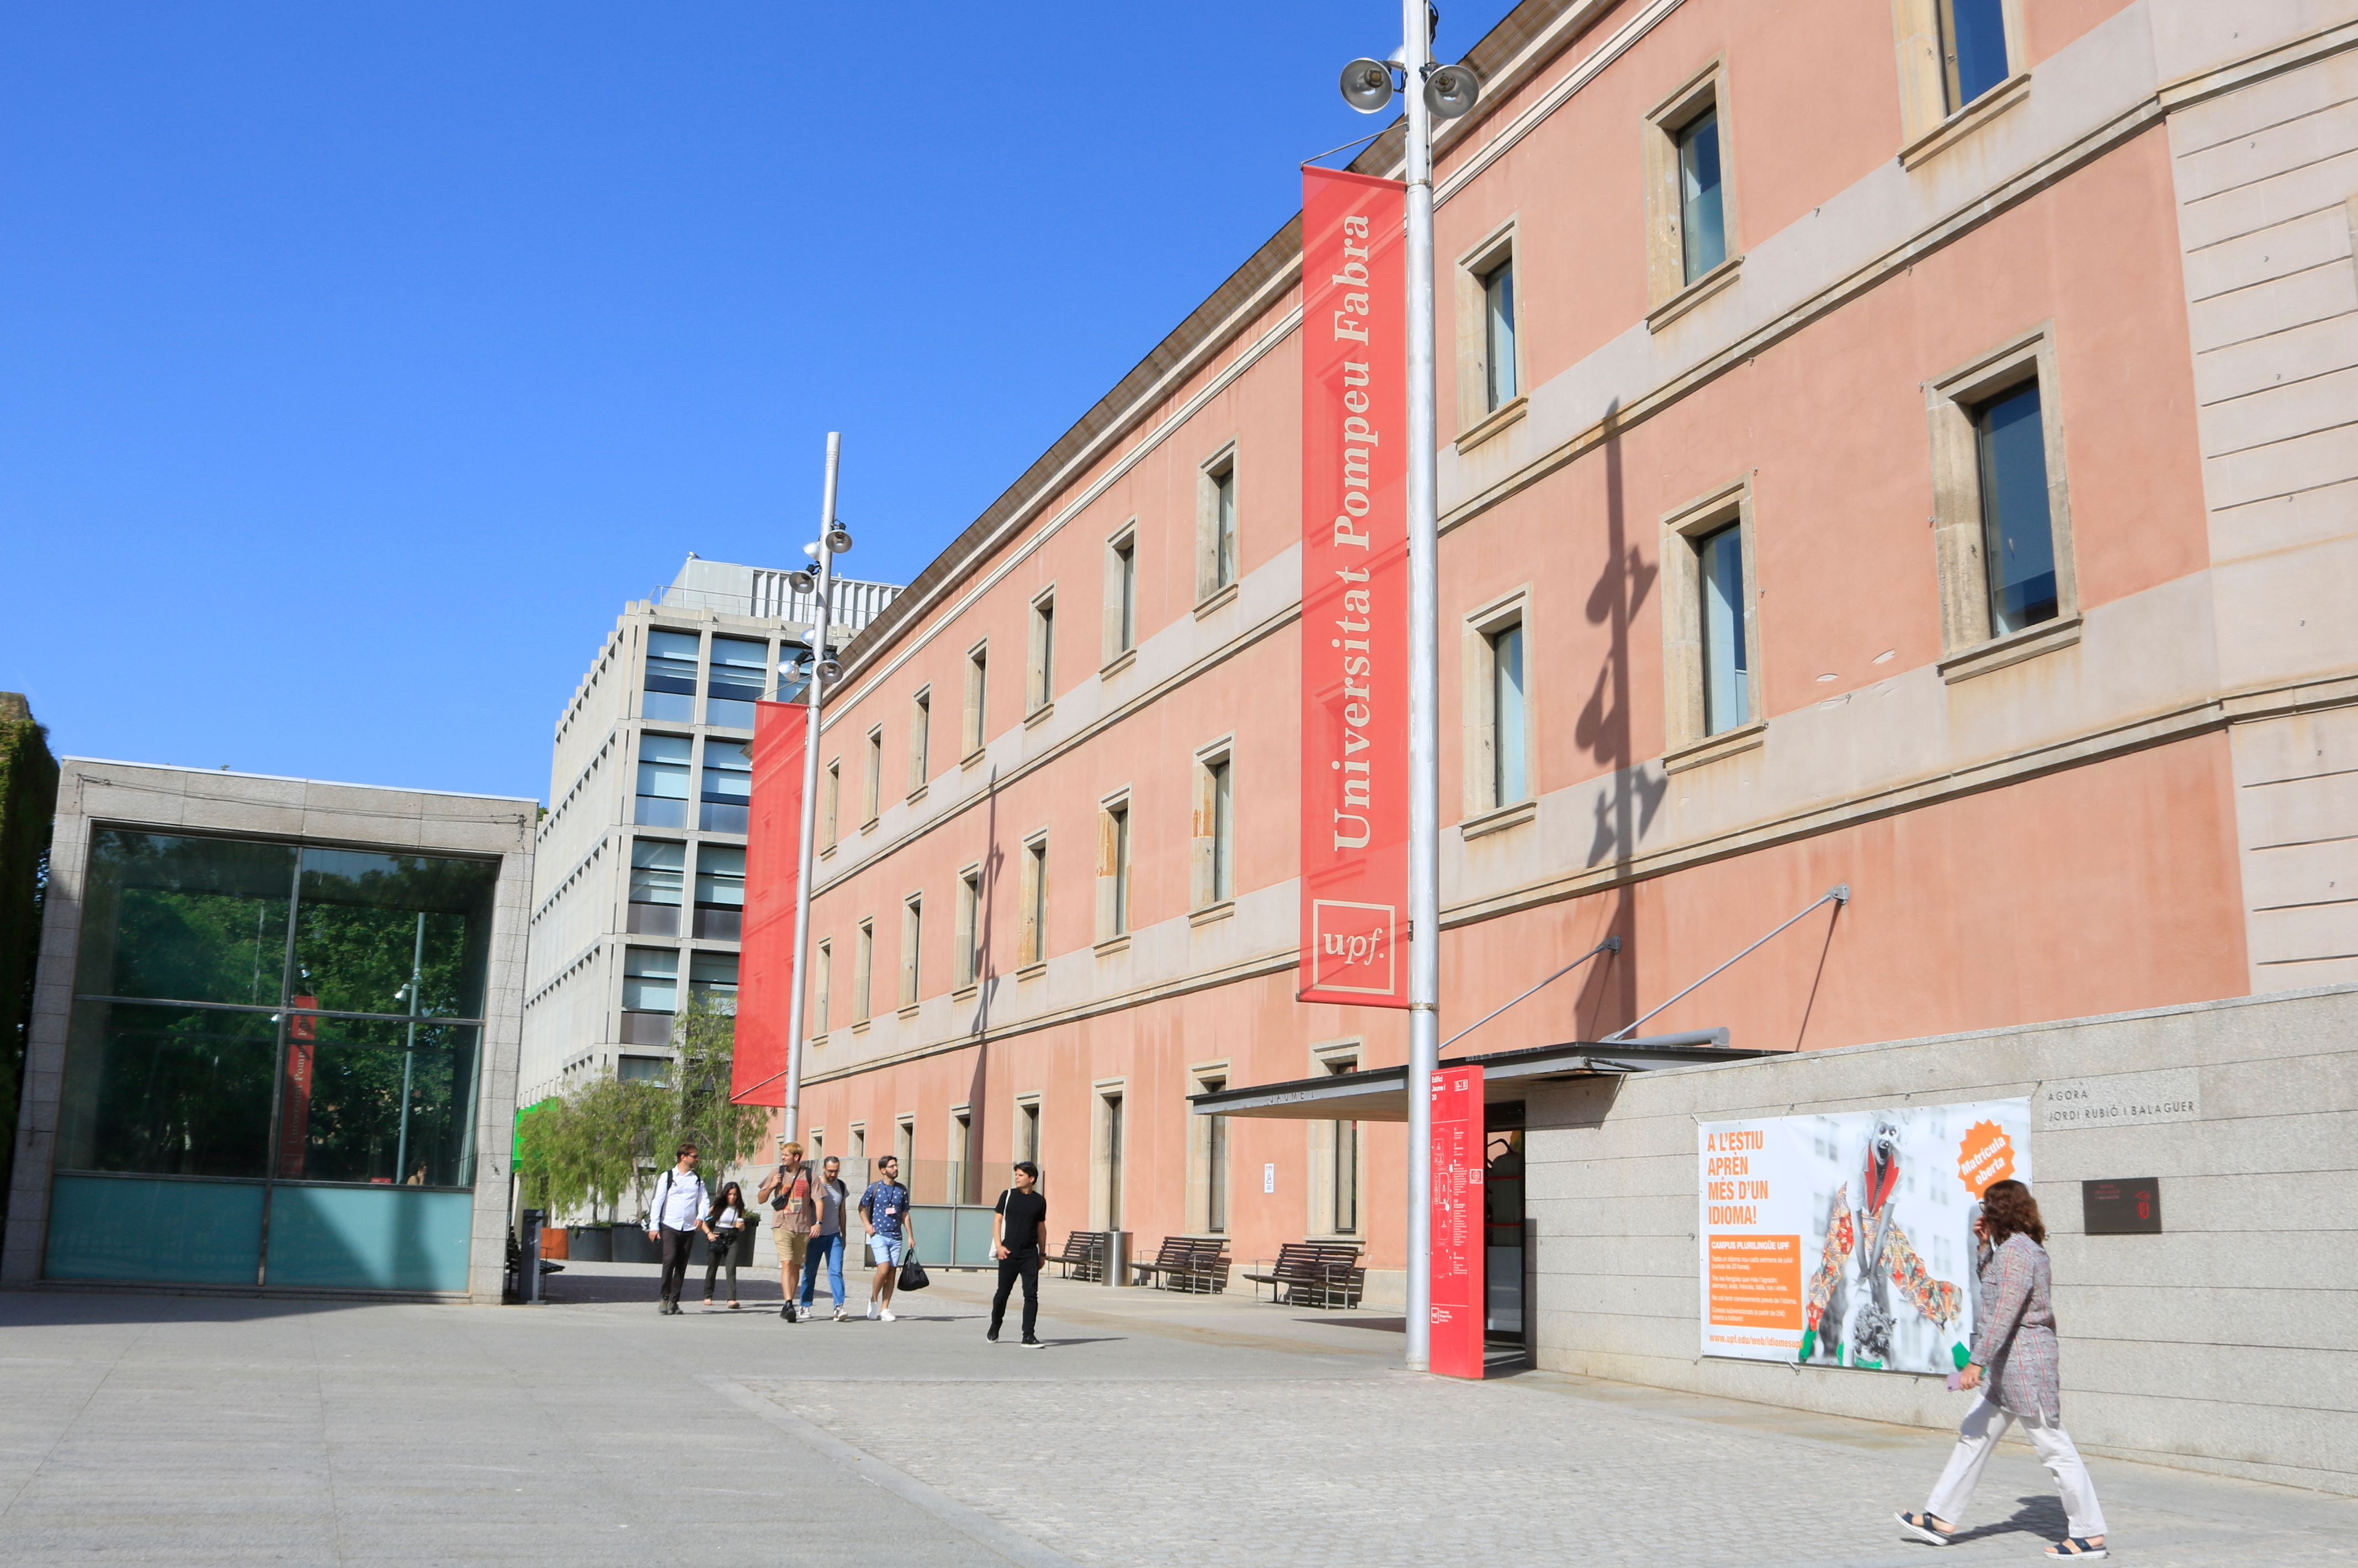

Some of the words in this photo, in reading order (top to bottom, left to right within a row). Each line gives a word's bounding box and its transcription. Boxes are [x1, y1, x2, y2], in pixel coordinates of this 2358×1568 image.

[1332, 215, 1370, 344] Fabra
[1334, 361, 1379, 549] Pompeu
[1331, 565, 1371, 852] Universitat
[1431, 1075, 1443, 1083] Edifici
[1270, 1091, 1304, 1103] JAUME
[2047, 1089, 2088, 1102] ÀGORA
[2048, 1110, 2080, 1122] JORDI
[2085, 1104, 2118, 1119] RUBIÓ
[2123, 1107, 2126, 1116] I
[2131, 1101, 2195, 1115] BALAGUER
[1707, 1133, 1716, 1152] A
[1707, 1151, 1749, 1176] APRÈN
[1960, 1136, 2006, 1176] Matrícula
[1974, 1157, 2006, 1186] oberta
[1708, 1176, 1735, 1200] MÉS
[1708, 1205, 1757, 1225] IDIOMA!
[1711, 1241, 1736, 1250] CAMPUS
[1736, 1240, 1776, 1250] PLURILINGÜE
[1777, 1241, 1790, 1250] UPF
